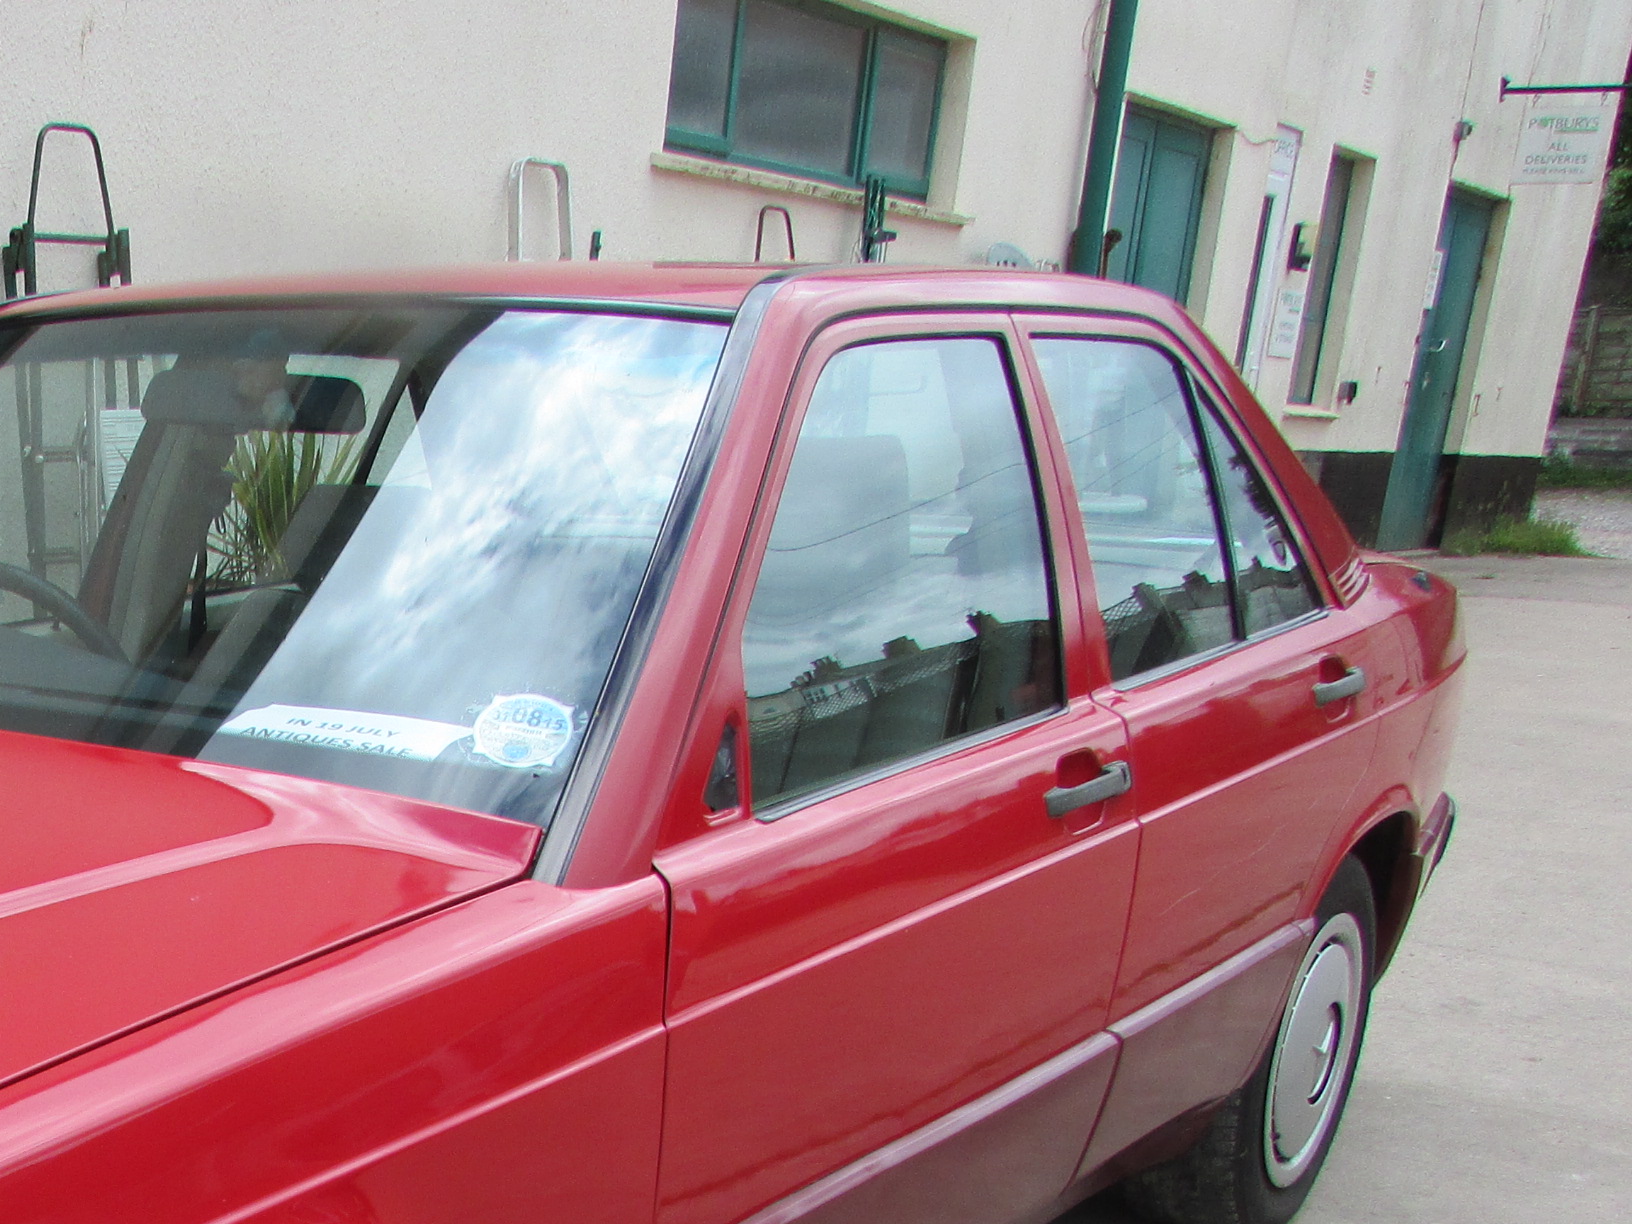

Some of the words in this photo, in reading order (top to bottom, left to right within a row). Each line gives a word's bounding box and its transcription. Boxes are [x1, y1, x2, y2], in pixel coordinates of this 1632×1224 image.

[1547, 142, 1569, 152] ALL
[1525, 154, 1588, 165] DELIVERIES
[286, 717, 312, 727] IN
[314, 721, 343, 731] 19
[344, 725, 401, 738] JULY
[240, 726, 354, 750] ANTIQUES
[356, 742, 413, 758] SALE
